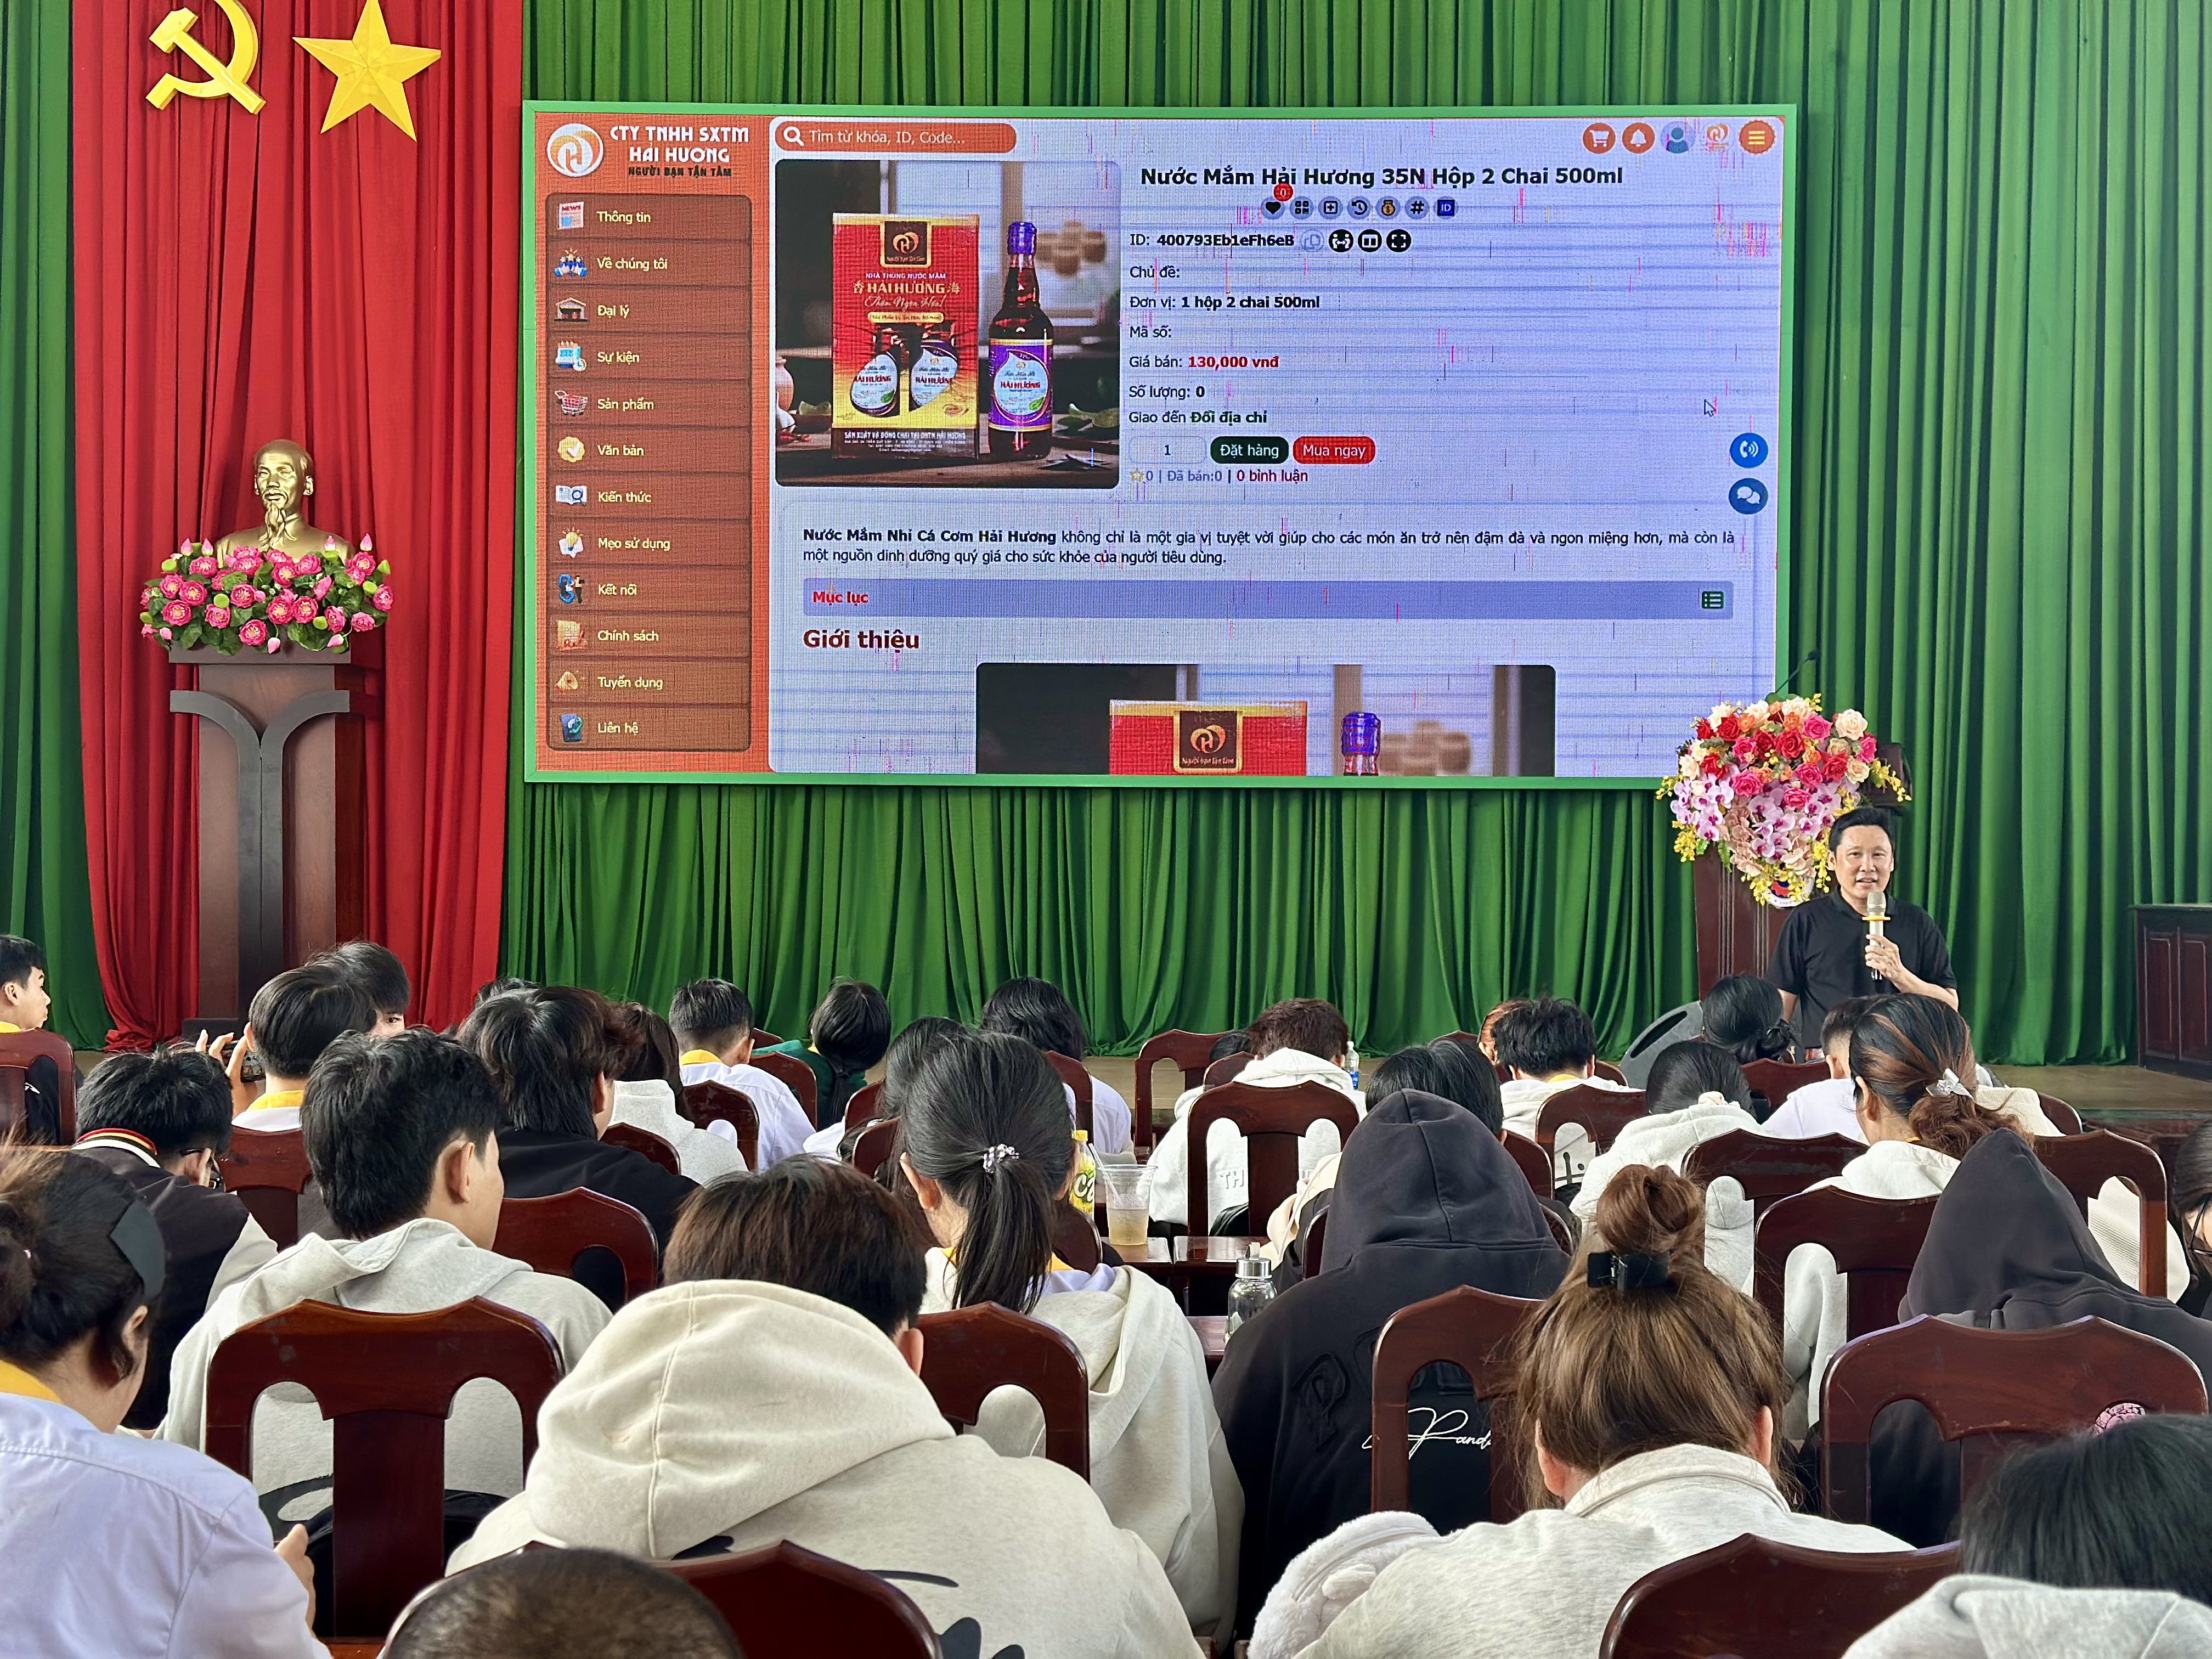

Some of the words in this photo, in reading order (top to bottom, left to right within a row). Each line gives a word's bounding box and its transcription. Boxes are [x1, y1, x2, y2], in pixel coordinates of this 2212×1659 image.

[610, 126, 640, 140] CTY
[646, 126, 693, 141] TNHH
[699, 127, 749, 142] SXTM
[809, 130, 833, 142] Tìm
[838, 129, 854, 143] từ
[856, 131, 890, 145] khóa,
[896, 132, 915, 145] ID,
[919, 132, 965, 144] Code...
[1142, 167, 1197, 185] Nước
[1204, 165, 1254, 185] Mắm
[1262, 166, 1296, 185] Hải
[1304, 168, 1375, 188] Hương
[1382, 168, 1425, 184] 35N
[1433, 168, 1475, 188] Hộp
[1482, 169, 1495, 184] 2
[1502, 168, 1549, 184] Chai
[1556, 167, 1623, 184] 500ml
[1441, 204, 1451, 212] ID
[596, 210, 633, 224] Thông
[636, 212, 651, 222] tin
[1130, 234, 1149, 246] ID:
[1157, 234, 1294, 247] 400793Eb1eFh6eB
[597, 257, 612, 269] Về
[615, 257, 650, 272] chúng
[653, 258, 668, 269] tôi
[1130, 265, 1154, 278] Chủ
[1159, 266, 1180, 278] đề:
[1130, 296, 1156, 308] Đơn
[1161, 297, 1175, 311] vị:
[1182, 297, 1189, 307] 1
[1195, 296, 1222, 311] hộp
[1226, 296, 1235, 308] 2
[1239, 296, 1269, 308] chai
[1274, 296, 1320, 308] 500ml
[597, 305, 616, 318] Đại
[620, 304, 630, 319] lý
[1130, 327, 1148, 337] Mã
[1153, 326, 1171, 337] số:
[597, 352, 614, 365] Sự
[617, 351, 640, 365] kiện
[1130, 356, 1150, 368] Giá
[1155, 356, 1183, 368] bán:
[1189, 356, 1248, 371] 130,000
[1252, 356, 1279, 368] vnđ
[1129, 386, 1146, 398] Số
[1149, 386, 1190, 400] lượng:
[1196, 386, 1205, 397] 0
[598, 398, 619, 409] Sản
[623, 397, 654, 411] phẩm
[1129, 412, 1158, 423] Giao
[1162, 411, 1186, 423] đến
[1190, 411, 1215, 423] Đổi
[1220, 411, 1241, 426] địa
[1245, 410, 1267, 423] chỉ
[597, 444, 619, 456] Văn
[623, 444, 644, 456] bản
[1164, 445, 1171, 455] 1
[1220, 444, 1243, 458] Đặt
[1248, 444, 1279, 459] hàng
[1303, 445, 1330, 456] Mua
[1335, 446, 1365, 459] ngay
[1167, 470, 1184, 482] Đã
[1187, 470, 1222, 482] bán:0
[1237, 471, 1245, 481] 0
[1250, 470, 1277, 482] bình
[1281, 470, 1308, 484] luận
[598, 491, 622, 503] Kiến
[626, 491, 651, 503] thức
[803, 528, 842, 541] Nước
[847, 527, 882, 541] Mắm
[887, 528, 912, 541] Nhỉ
[918, 529, 935, 542] Cá
[941, 530, 973, 542] Cơm
[979, 530, 1002, 542] Hải
[1008, 531, 1056, 545] Hương
[1062, 531, 1100, 545] không
[1106, 531, 1125, 543] chỉ
[1130, 531, 1141, 543] là
[1147, 531, 1171, 544] một
[1176, 532, 1195, 546] gia
[1200, 532, 1211, 546] vị
[1216, 532, 1250, 546] tuyệt
[1255, 531, 1273, 543] vời
[1279, 531, 1306, 546] giúp
[1312, 532, 1335, 544] cho
[1340, 531, 1362, 544] các
[1367, 531, 1395, 544] món
[1401, 531, 1416, 544] ăn
[1421, 532, 1441, 544] trở
[1446, 532, 1469, 544] nên
[1474, 532, 1503, 546] đậm
[1508, 532, 1525, 544] đà
[1530, 532, 1545, 544] và
[1551, 532, 1583, 546] ngon
[1588, 531, 1628, 546] miệng
[1634, 531, 1663, 545] hơn,
[1669, 531, 1689, 543] mà
[1694, 532, 1717, 544] còn
[1723, 532, 1735, 544] là
[598, 538, 622, 551] Mẹo
[625, 537, 640, 549] sử
[642, 538, 670, 551] dụng
[803, 549, 828, 562] một
[833, 549, 872, 564] nguồn
[877, 550, 904, 562] dinh
[909, 550, 950, 564] dưỡng
[954, 550, 978, 565] quý
[982, 550, 1001, 565] giá
[1005, 551, 1028, 562] cho
[1032, 550, 1054, 563] sức
[1059, 551, 1090, 563] khỏe
[1094, 551, 1116, 563] của
[1121, 551, 1157, 566] người
[1161, 550, 1186, 563] tiêu
[1190, 551, 1226, 566] dùng.
[598, 584, 617, 595] Kết
[620, 583, 636, 595] nối
[812, 591, 843, 606] Mục
[847, 591, 868, 606] lục
[597, 630, 630, 641] Chính
[634, 630, 658, 641] sách
[803, 629, 850, 648] Giới
[857, 630, 919, 653] thiệu
[597, 675, 631, 689] Tuyển
[635, 677, 663, 690] dụng
[597, 723, 621, 733] Liên
[625, 722, 639, 736] hệ
